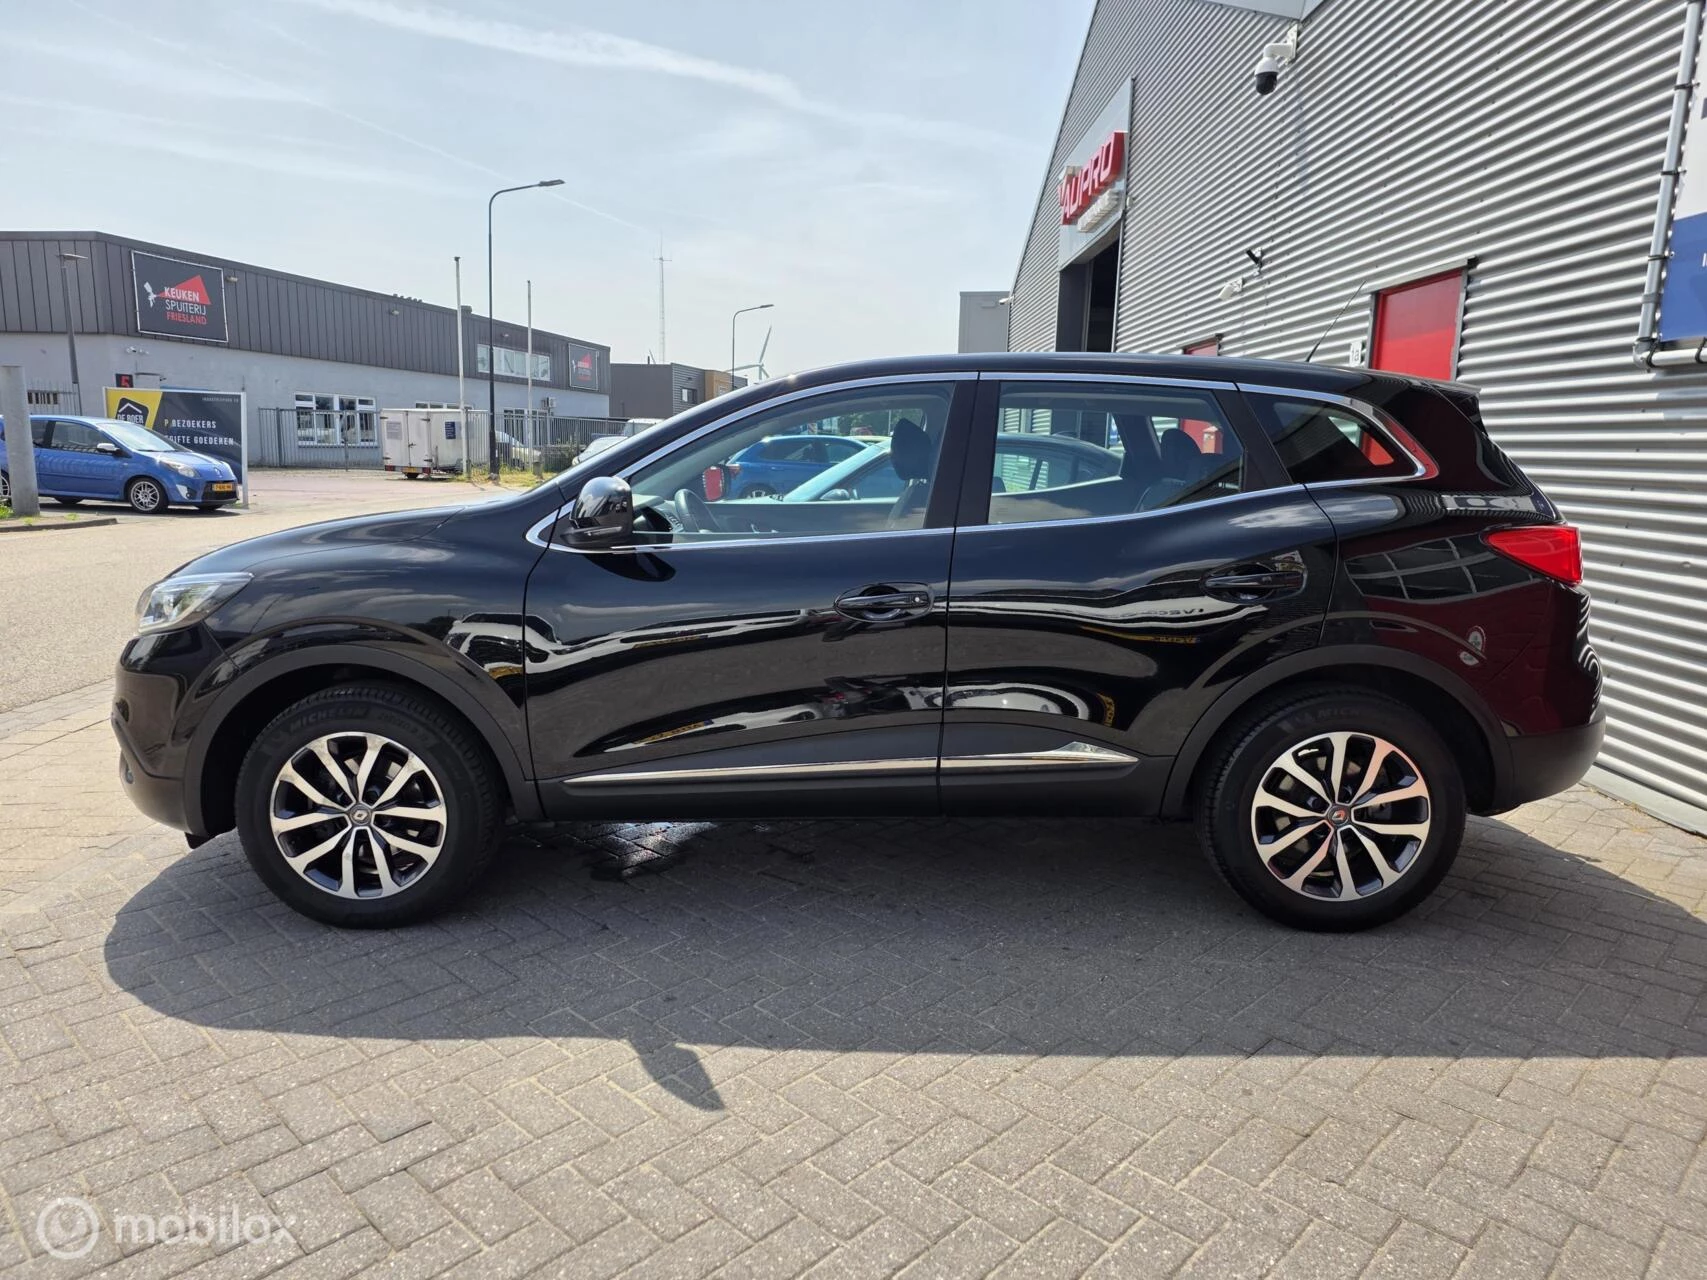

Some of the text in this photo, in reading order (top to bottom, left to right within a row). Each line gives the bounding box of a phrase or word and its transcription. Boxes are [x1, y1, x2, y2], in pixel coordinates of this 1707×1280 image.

[164, 286, 200, 302] KEUKEN
[165, 299, 207, 315] SPUITERIJ
[166, 311, 207, 325] FRIESLAND
[171, 419, 217, 429] BEZOEKERS
[193, 436, 234, 446] GOEDEREN
